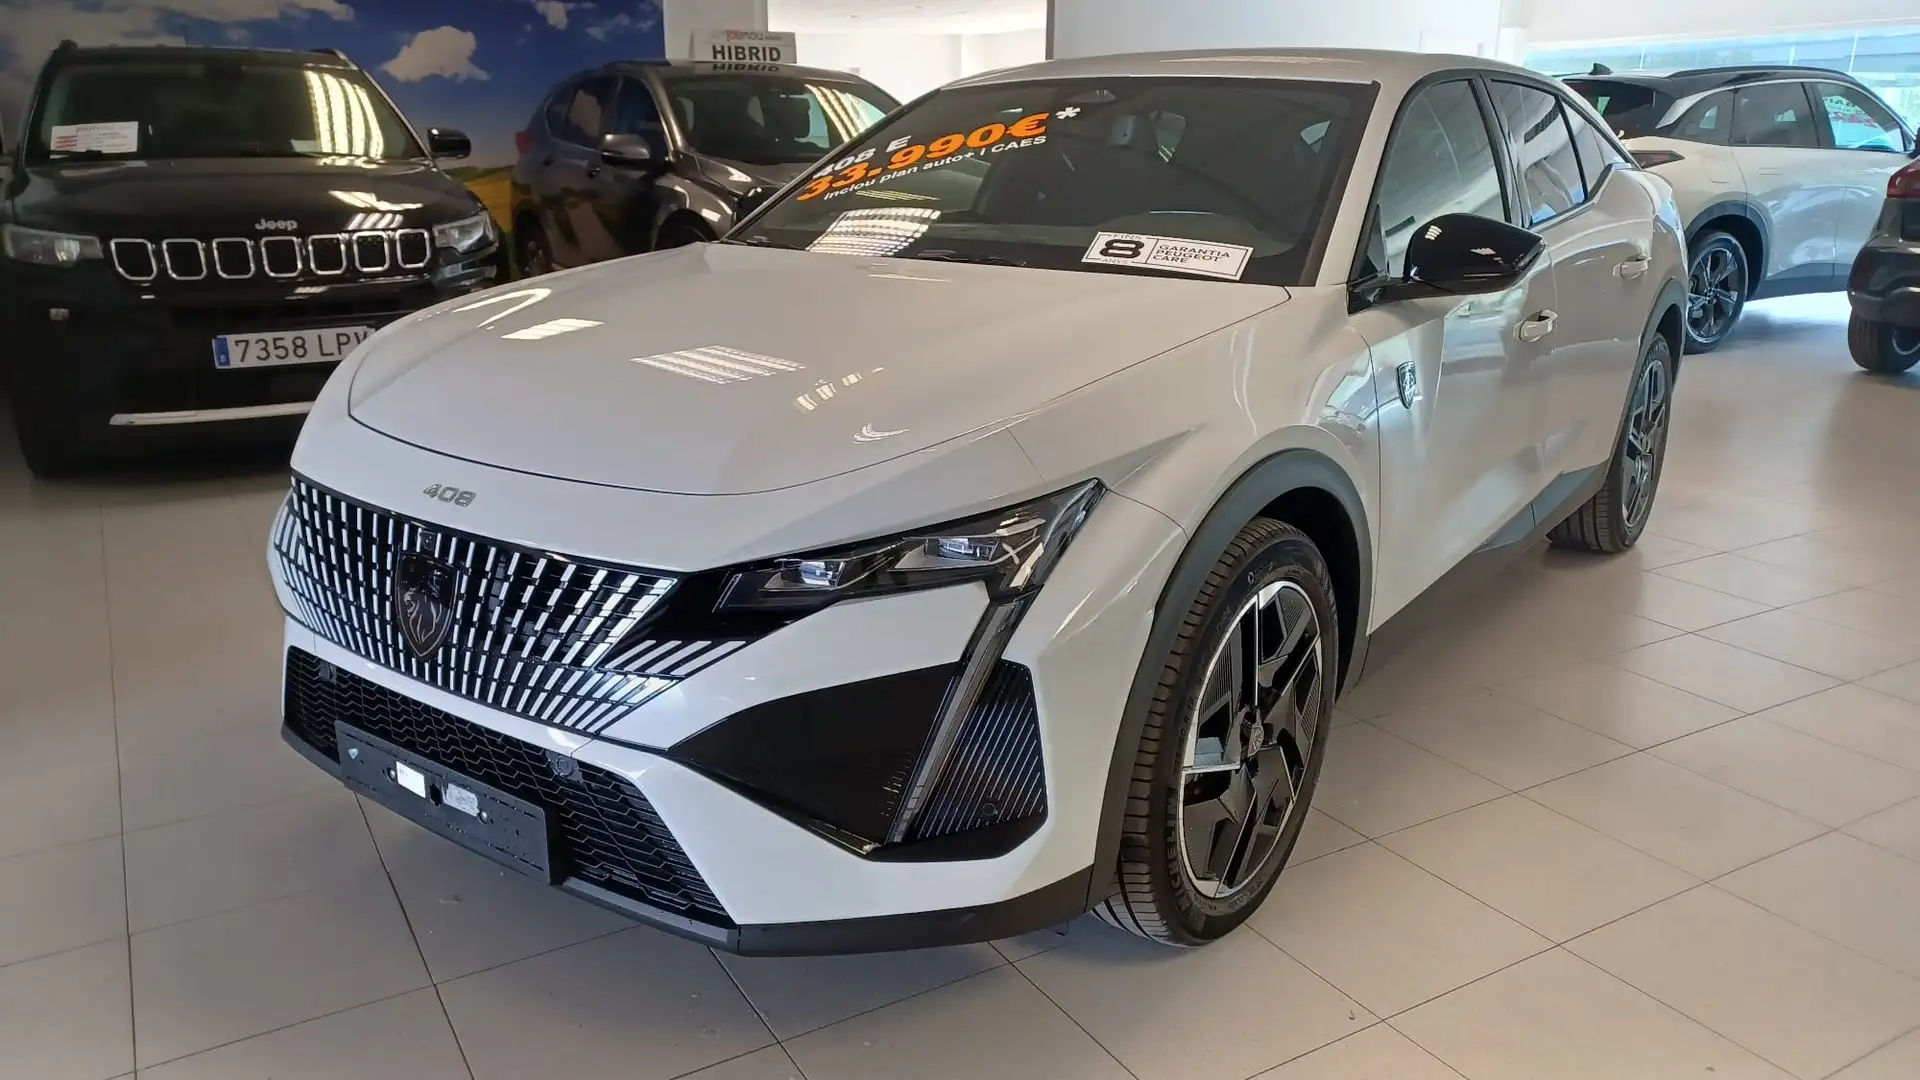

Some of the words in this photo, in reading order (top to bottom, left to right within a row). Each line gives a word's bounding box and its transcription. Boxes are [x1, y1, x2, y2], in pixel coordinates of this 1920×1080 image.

[712, 45, 781, 61] HIBRID
[797, 112, 1050, 201] 33.990€
[812, 148, 877, 179] 408
[886, 135, 912, 153] E
[880, 166, 918, 183] plan
[991, 135, 1047, 153] CAES
[255, 218, 297, 231] Jeep
[1100, 239, 1144, 258] 8
[1156, 249, 1222, 261] PEUGEOT
[1159, 245, 1230, 257] GARANTIA
[234, 336, 307, 362] 7358
[422, 483, 477, 507] 408
